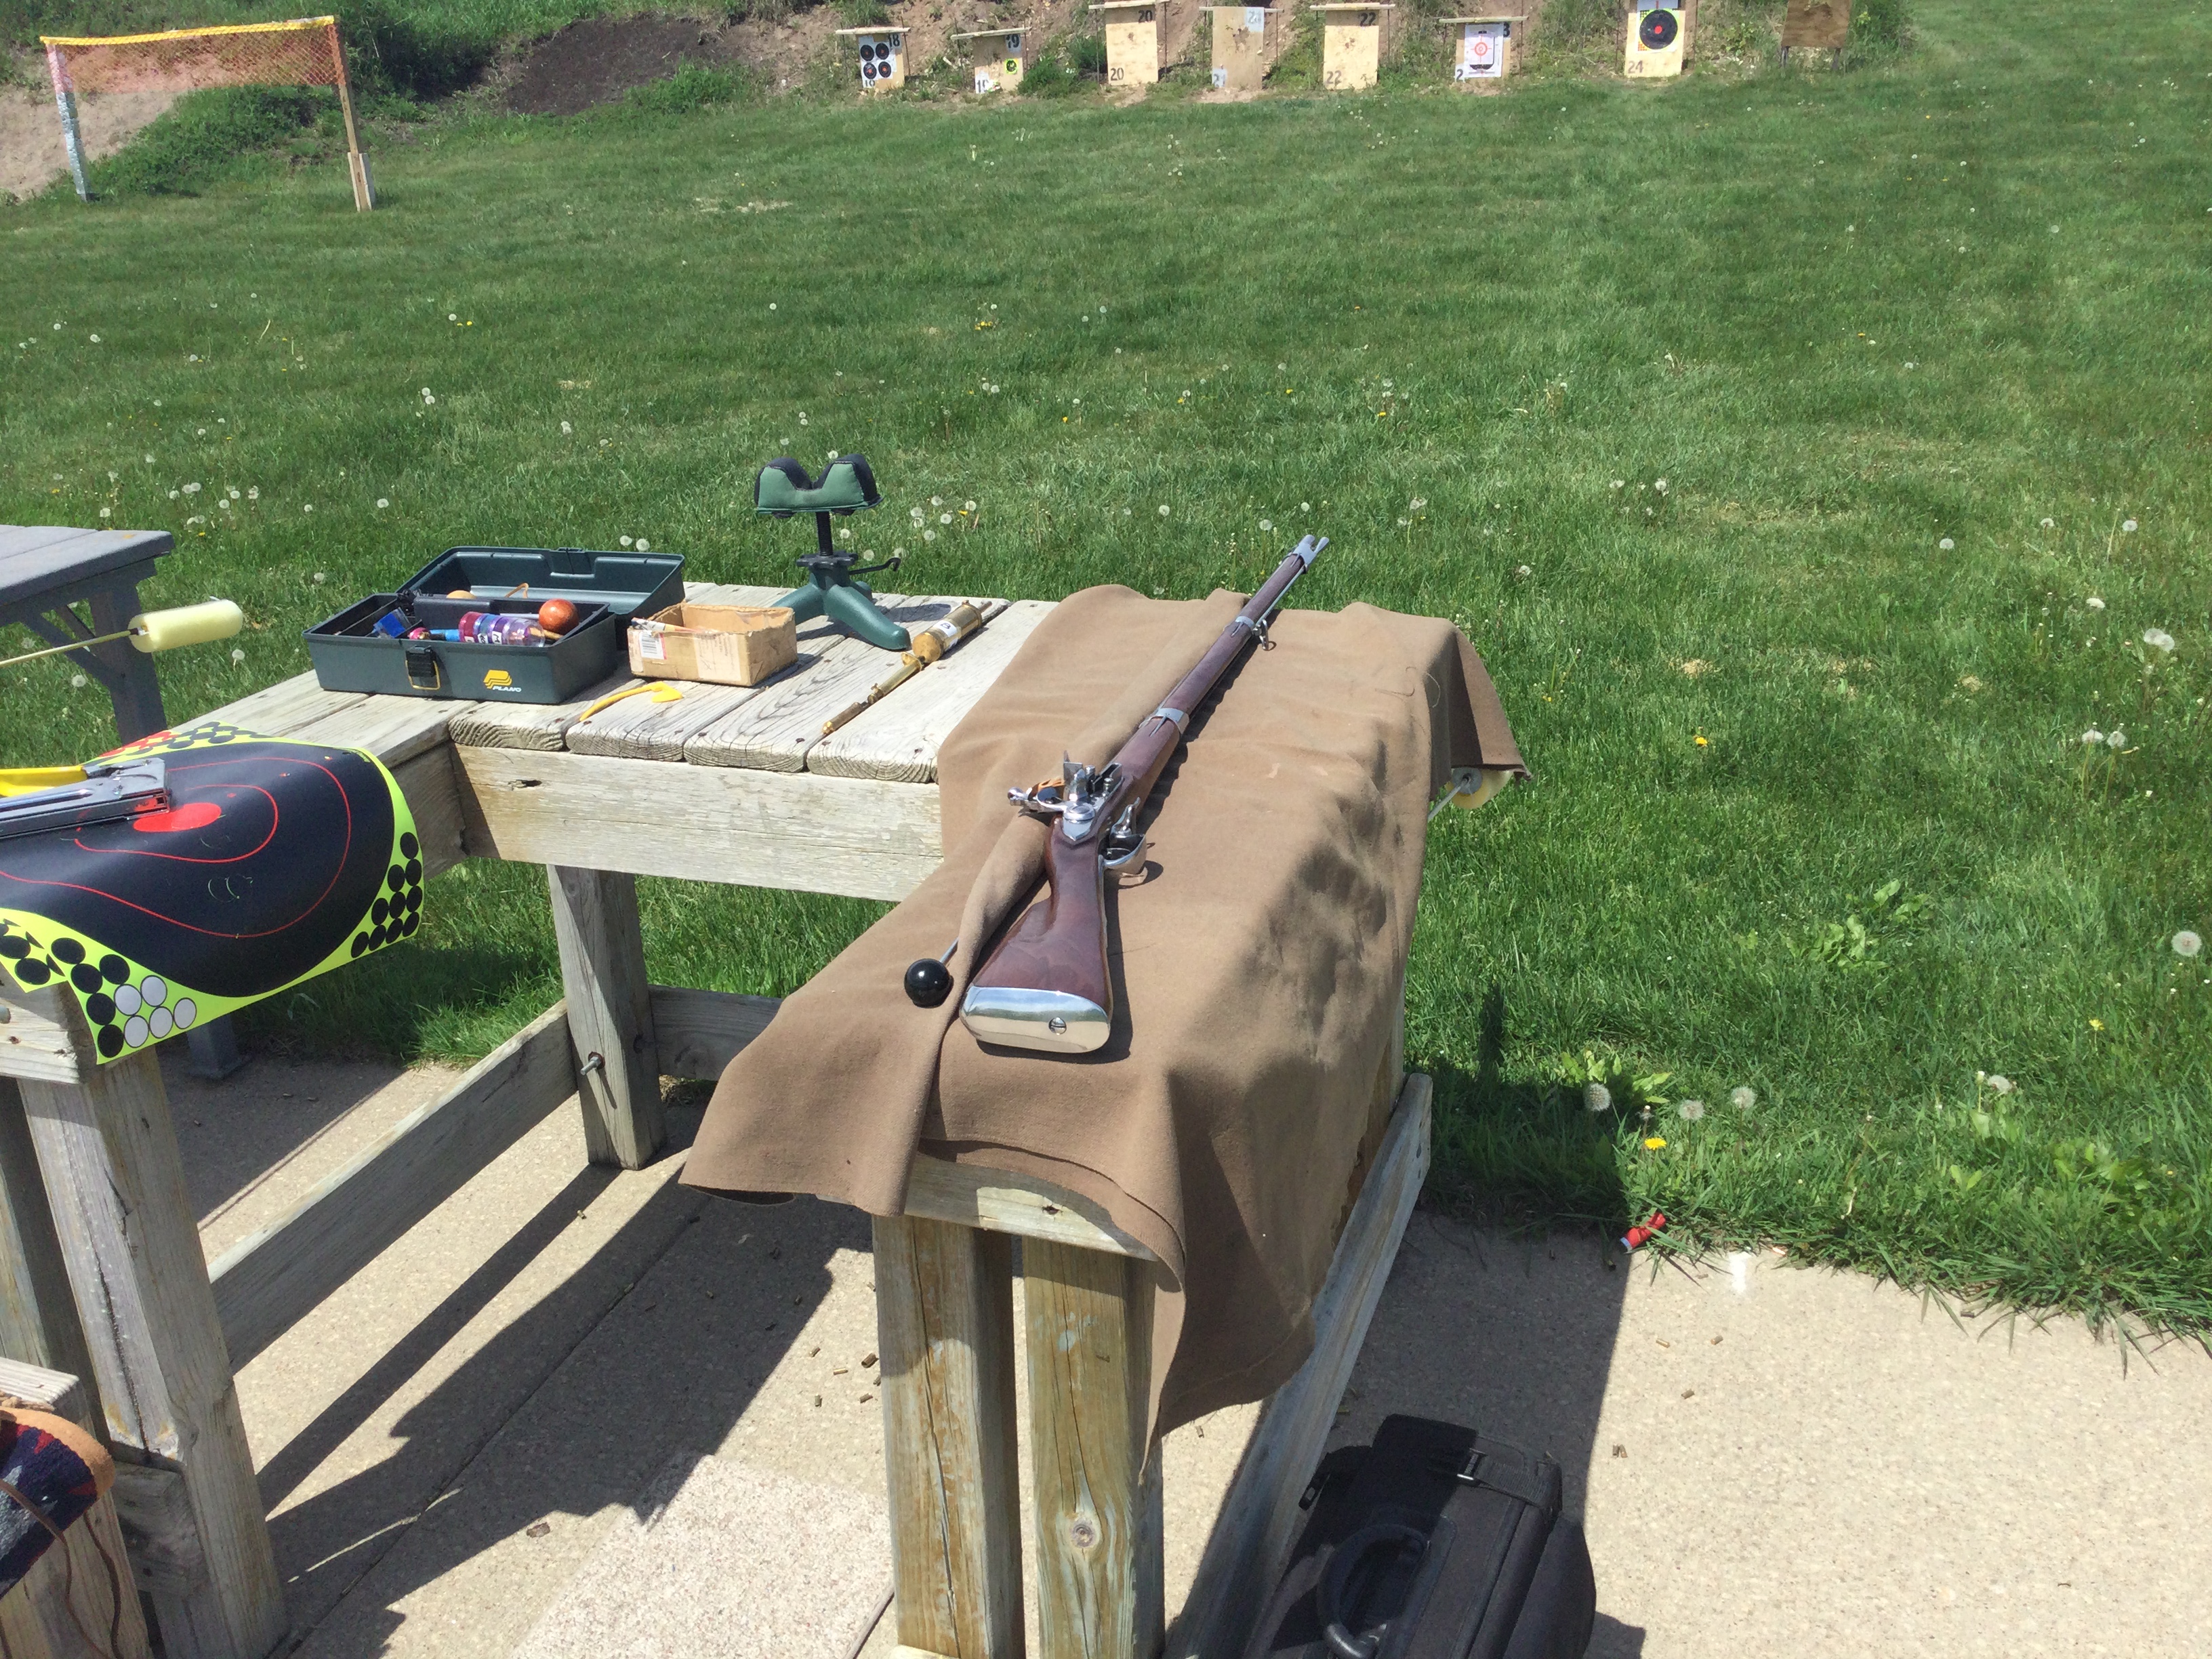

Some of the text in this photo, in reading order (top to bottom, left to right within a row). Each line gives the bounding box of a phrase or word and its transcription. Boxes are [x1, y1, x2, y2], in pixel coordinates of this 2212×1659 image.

[1139, 10, 1152, 22] 20
[1359, 12, 1376, 26] 22
[888, 33, 900, 47] 18
[1006, 34, 1019, 48] 19
[1110, 67, 1124, 81] 20
[1628, 60, 1643, 74] 24
[1326, 70, 1342, 86] 22
